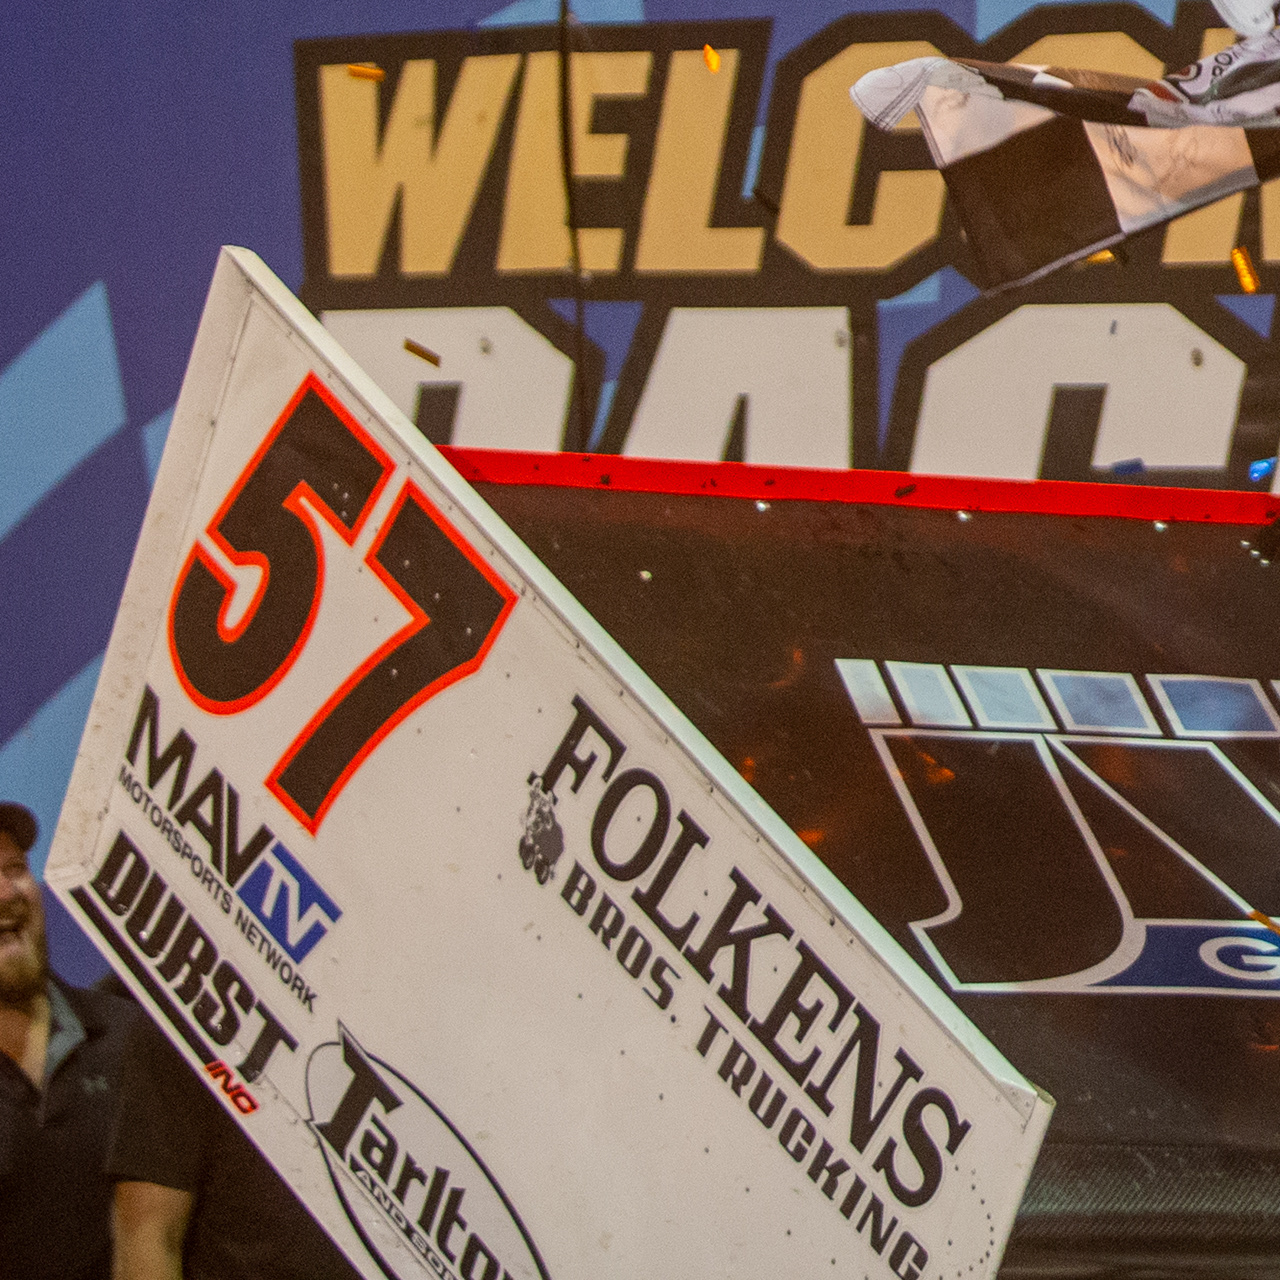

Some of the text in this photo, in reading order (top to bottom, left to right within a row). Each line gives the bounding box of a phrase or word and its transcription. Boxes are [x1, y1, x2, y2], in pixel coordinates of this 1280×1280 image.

[168, 370, 519, 838] 57
[90, 829, 300, 1085] DURST
[117, 764, 319, 1014] MOTORSPORTS NETWORK
[527, 694, 973, 1209] FOLKENS
[203, 1057, 261, 1115] INC
[312, 1020, 514, 1280] Tarlto
[560, 859, 931, 1280] BROS. TRUCKING
[352, 1166, 413, 1234] AND
